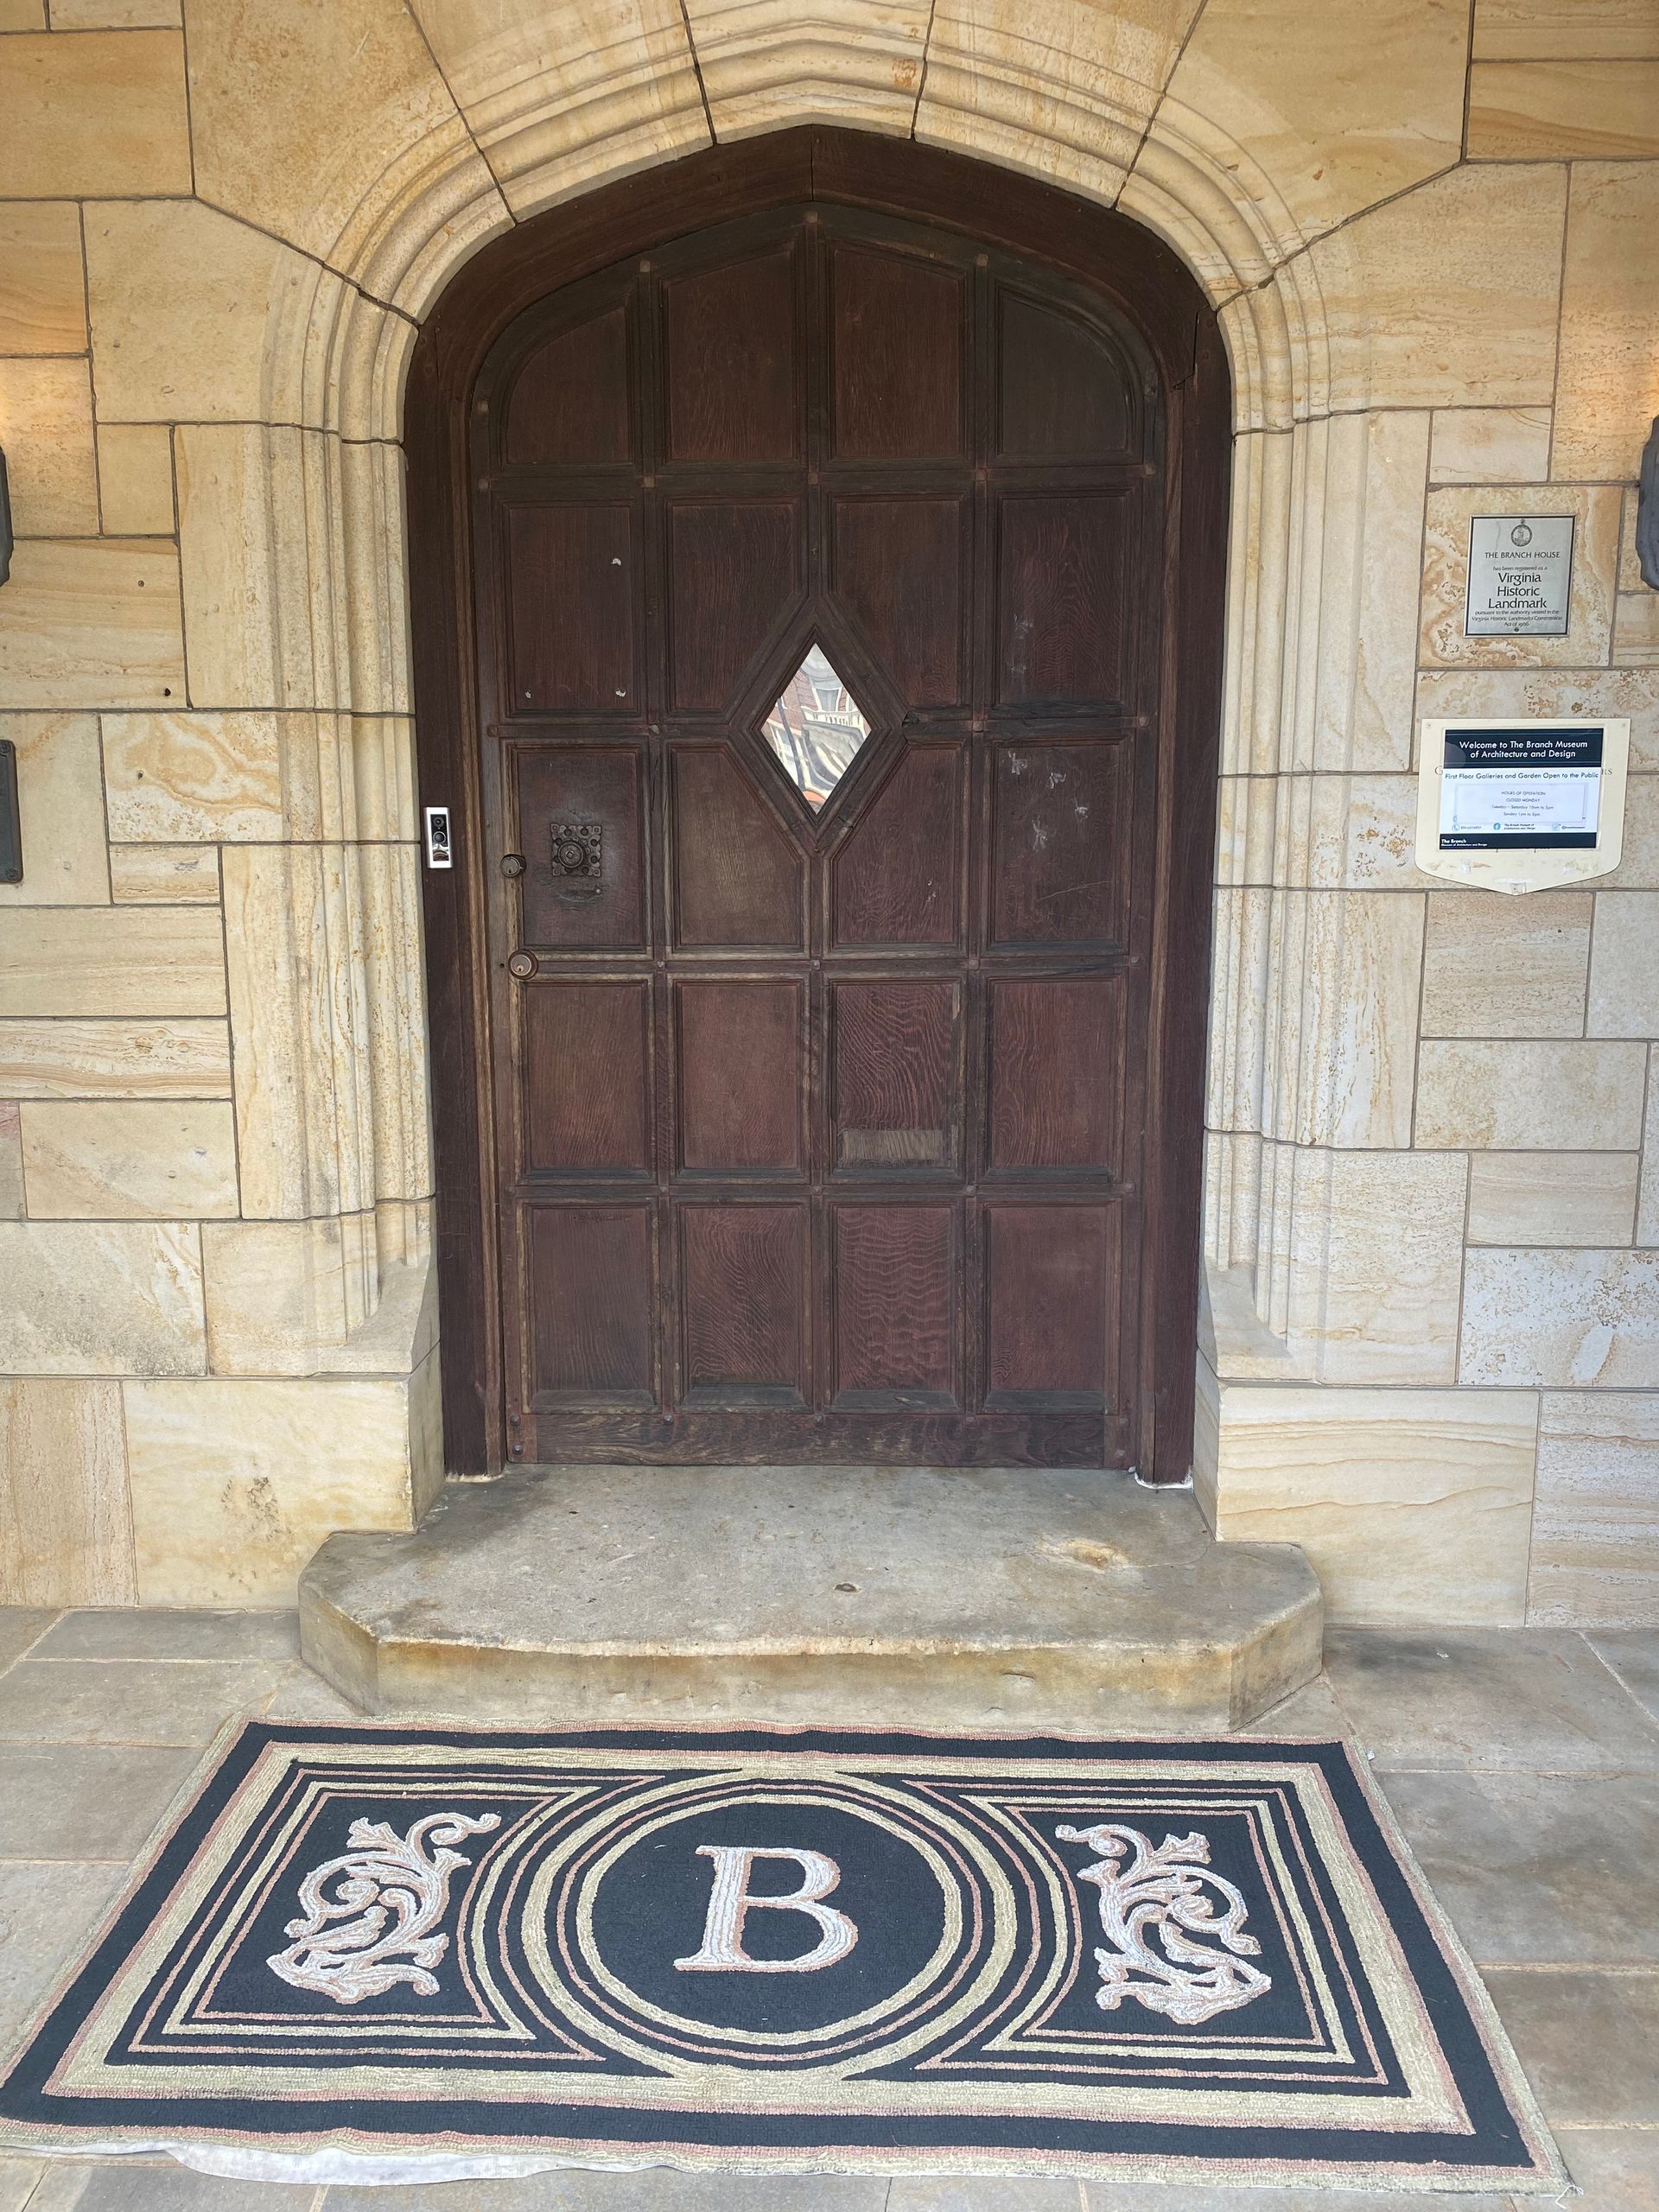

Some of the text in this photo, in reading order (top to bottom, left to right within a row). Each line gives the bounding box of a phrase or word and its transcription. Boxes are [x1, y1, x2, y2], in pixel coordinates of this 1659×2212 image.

[1498, 572, 1541, 586] Virginia
[1497, 586, 1541, 596] Historic
[1488, 597, 1548, 608] Landmark
[1459, 741, 1497, 749] Welcome
[1548, 749, 1576, 759] Design
[673, 1844, 859, 1973] B
